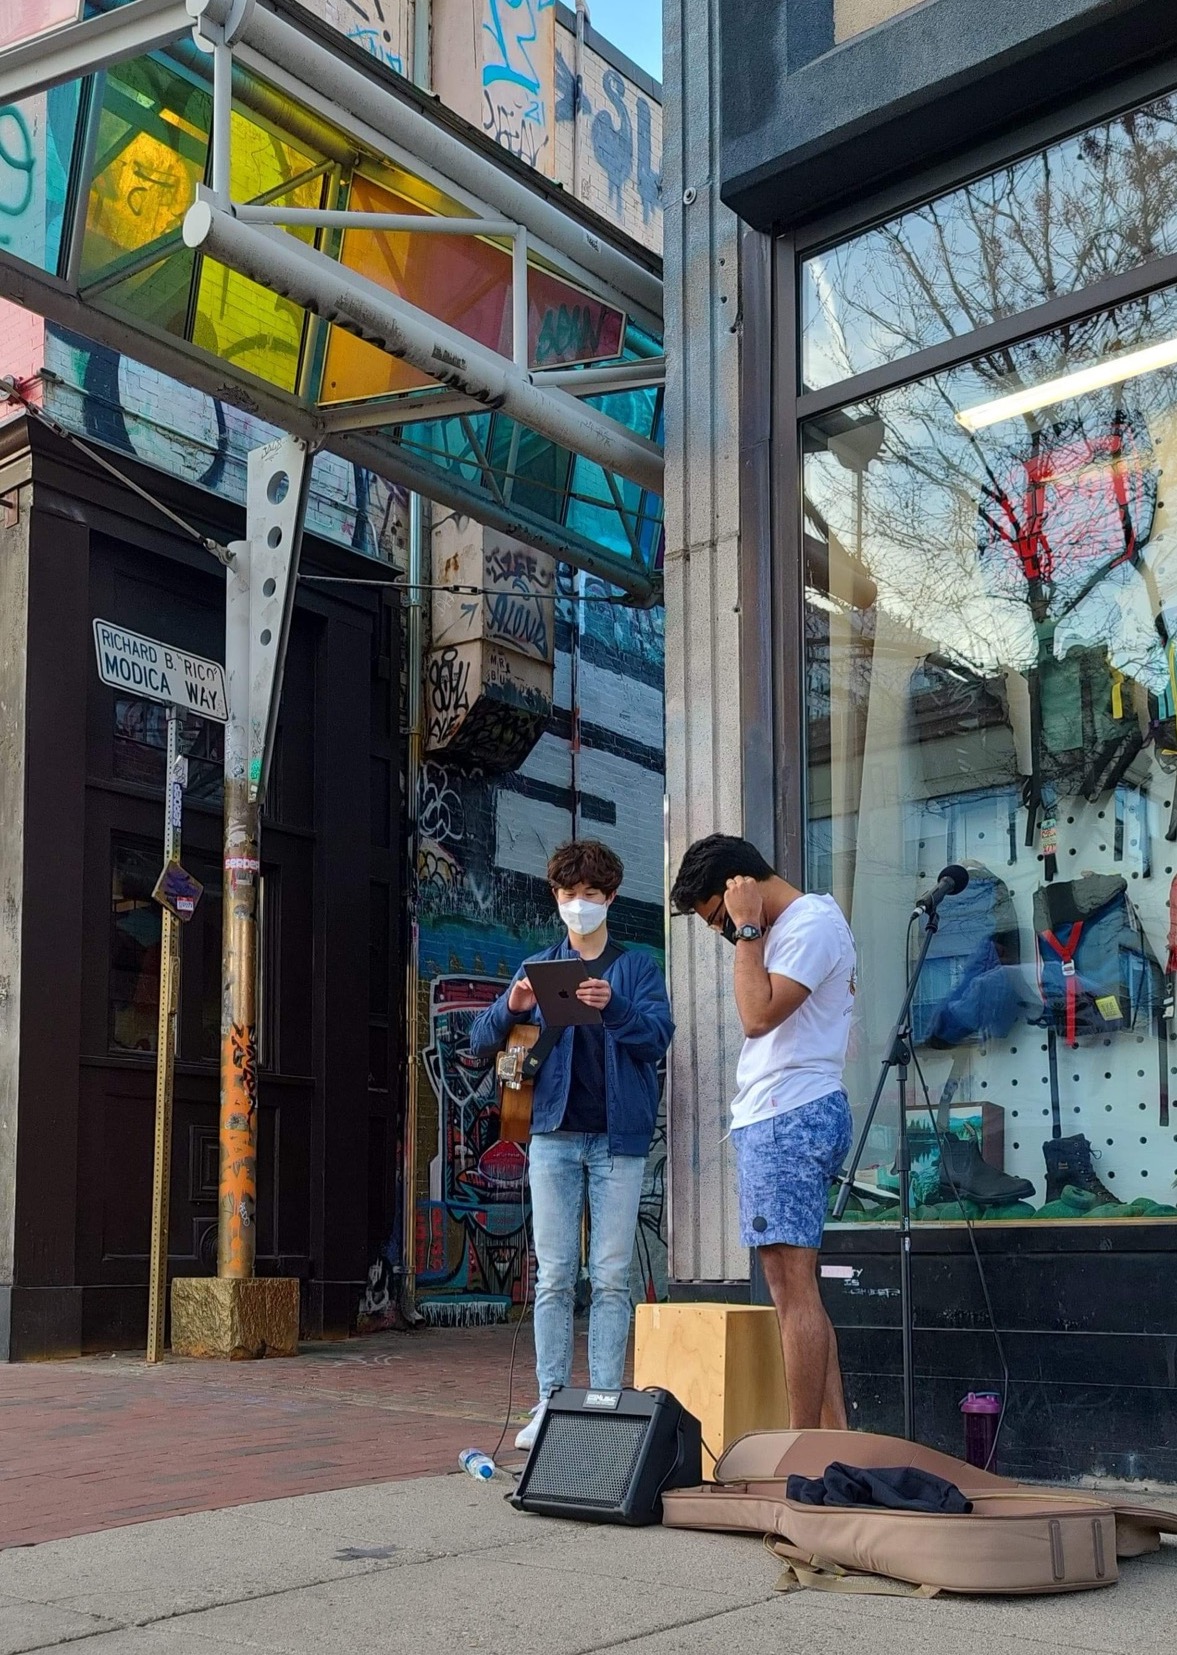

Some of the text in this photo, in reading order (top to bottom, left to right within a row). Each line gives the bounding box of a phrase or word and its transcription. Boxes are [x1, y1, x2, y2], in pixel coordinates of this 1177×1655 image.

[101, 628, 158, 664] RICHARD
[164, 652, 177, 671] B.
[104, 652, 217, 711] MODICA WAY
